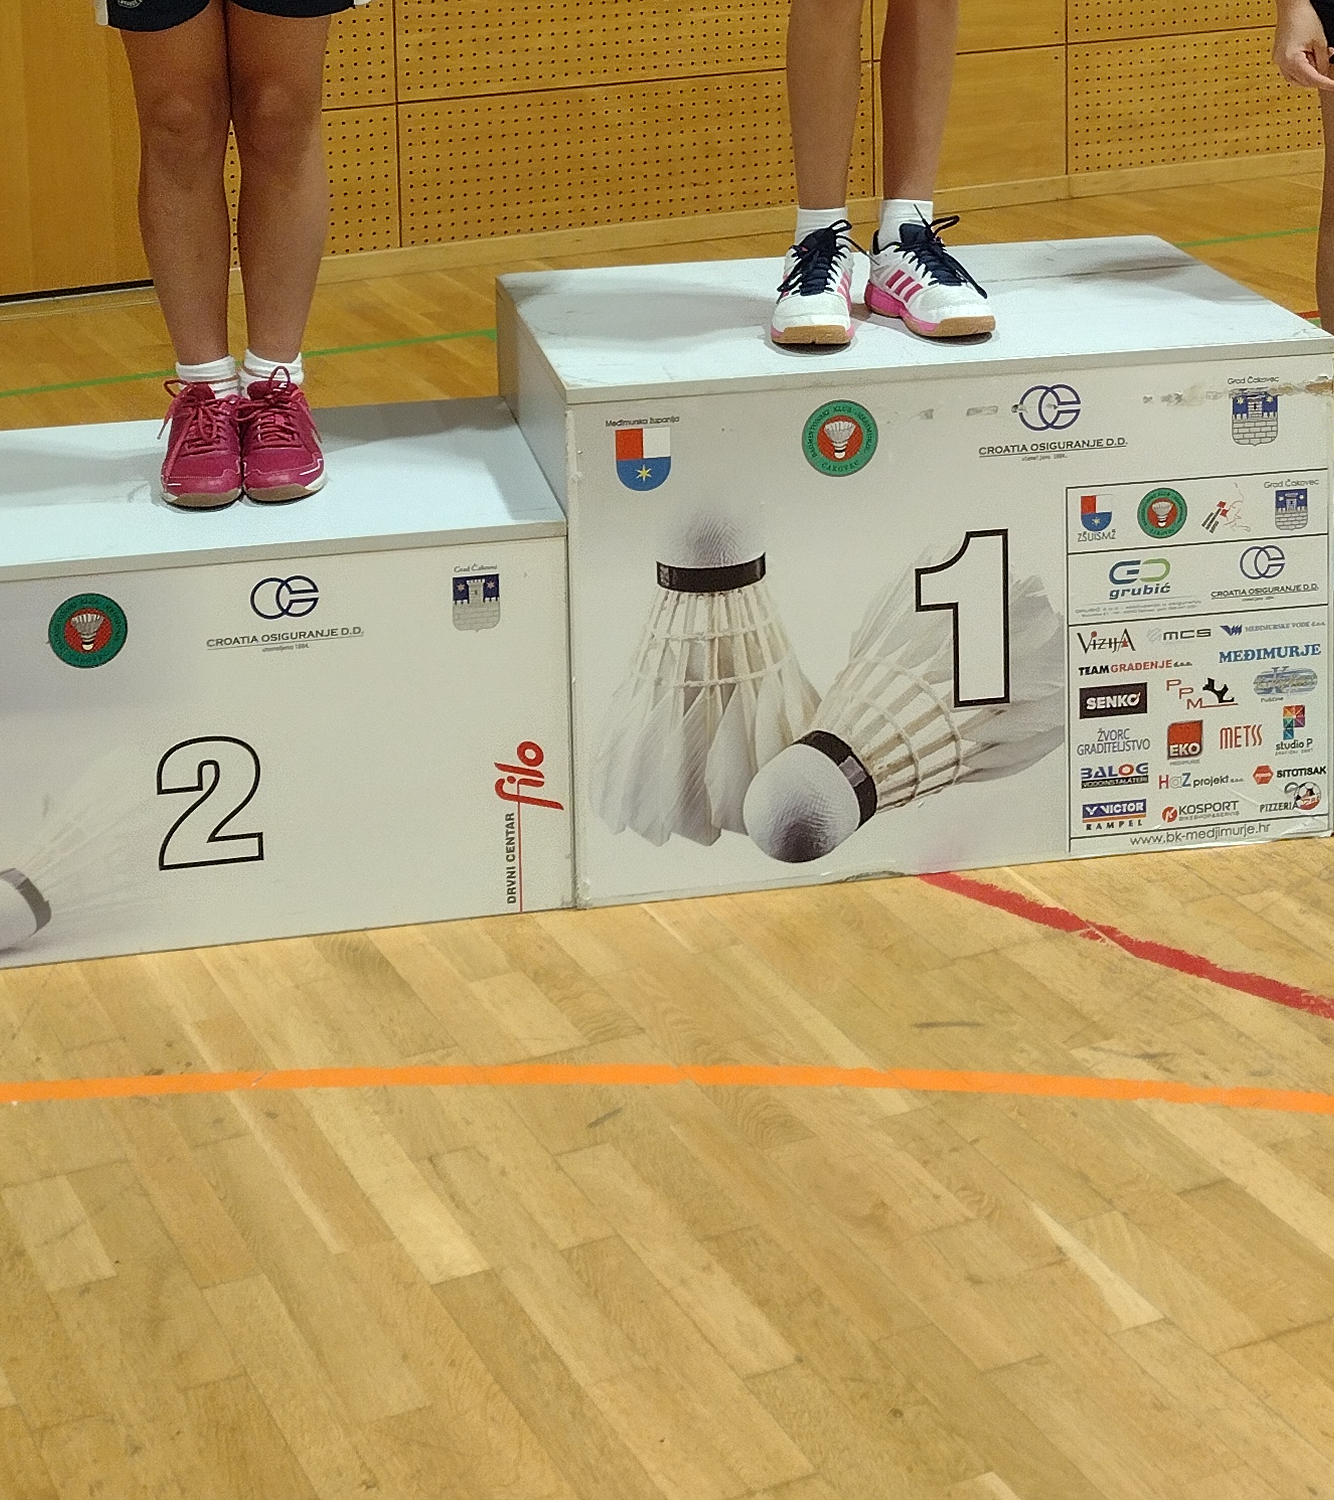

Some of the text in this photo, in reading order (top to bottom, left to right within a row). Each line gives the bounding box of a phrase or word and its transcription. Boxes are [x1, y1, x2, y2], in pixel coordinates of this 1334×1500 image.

[978, 437, 1128, 456] CROATIA OSIGURANJE D.D.
[1109, 581, 1171, 600] grubić
[1210, 589, 1246, 598] CROATIA
[1248, 584, 1302, 595] OSIGURANJE
[915, 528, 1010, 707] 1
[207, 626, 365, 647] CROATIA OSIGURANJE D.D.
[1078, 665, 1110, 676] TEAM
[1086, 691, 1142, 711] SENKO
[1097, 727, 1131, 742] ŽVORC
[1169, 742, 1201, 757] EKO
[1275, 737, 1313, 751] studio P
[494, 740, 565, 810] filo
[1276, 765, 1327, 779] SITOTISAK
[1193, 775, 1229, 788] projekt
[156, 735, 264, 870] 2
[1100, 802, 1144, 815] VICTOR
[1178, 800, 1240, 816] KOSPORT
[1260, 800, 1299, 813] PIZZERIA
[1085, 819, 1143, 831] RAMPEL
[1130, 822, 1271, 846] www.bk-medjimurje.hr
[505, 812, 517, 904] DRVNI CENTAR
